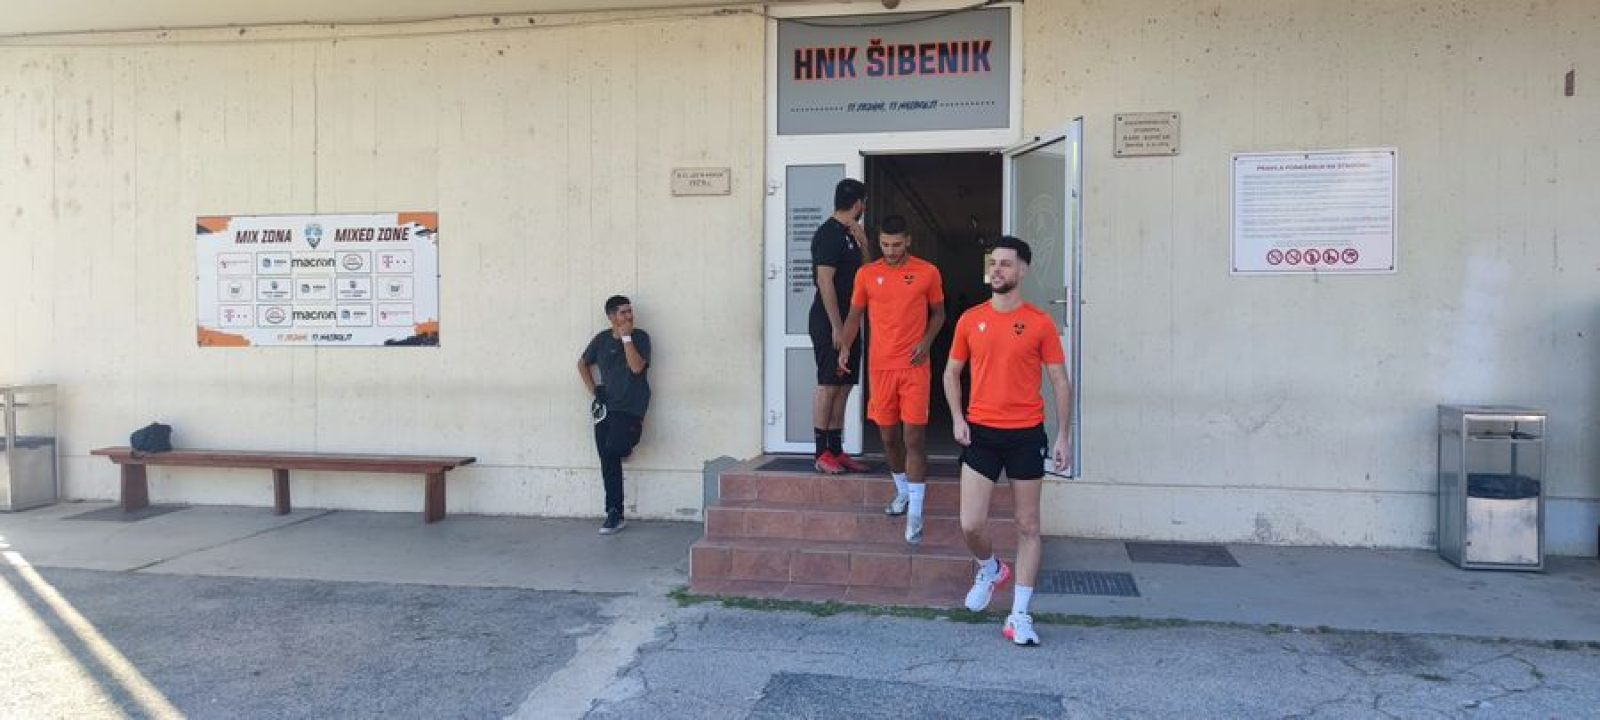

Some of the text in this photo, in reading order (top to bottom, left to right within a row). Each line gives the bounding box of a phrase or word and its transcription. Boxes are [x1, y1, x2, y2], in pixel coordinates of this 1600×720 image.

[793, 38, 993, 81] HNK ŠIBENIK
[235, 228, 293, 245] MIX ZONA
[334, 226, 410, 243] MIXED ZONE
[291, 256, 336, 269] macron
[292, 308, 337, 322] macron
